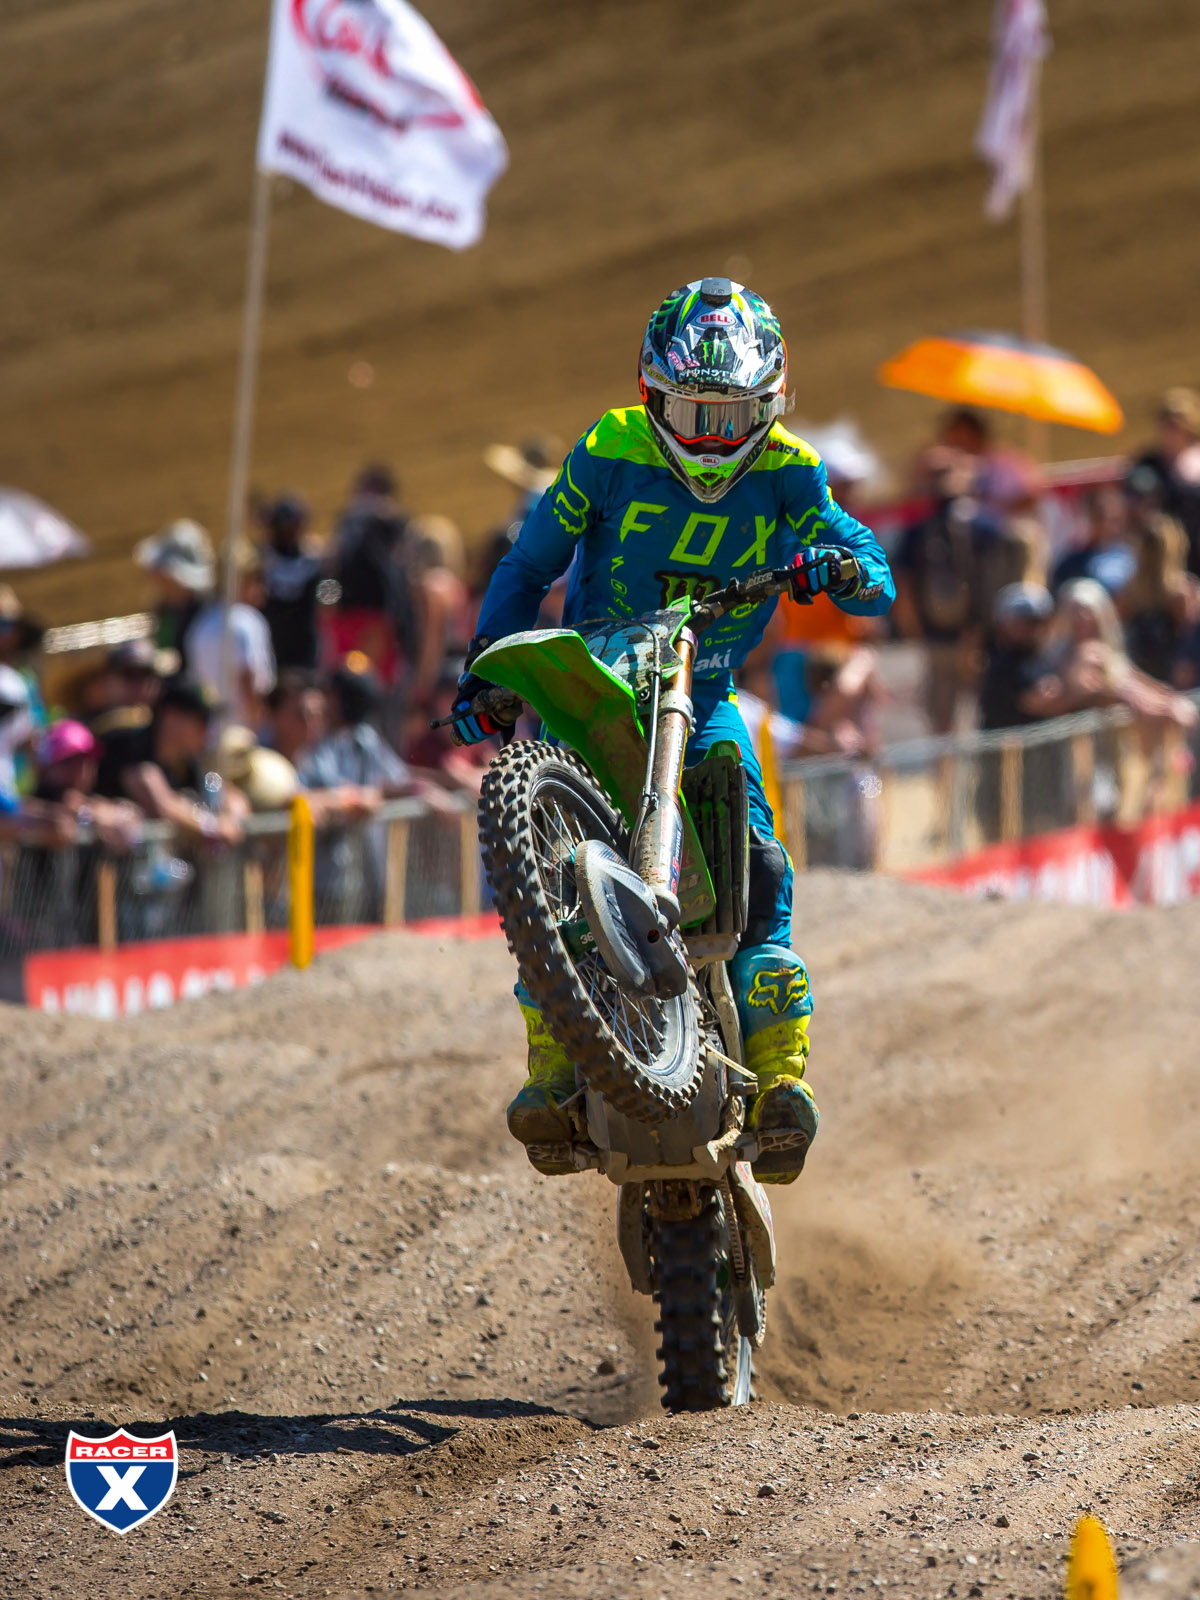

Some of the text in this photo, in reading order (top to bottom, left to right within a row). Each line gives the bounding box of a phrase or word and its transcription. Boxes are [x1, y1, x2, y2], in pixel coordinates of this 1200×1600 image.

[700, 314, 730, 324] BELL
[678, 368, 744, 379] MONST
[620, 501, 776, 567] FOX
[693, 648, 732, 672] aki
